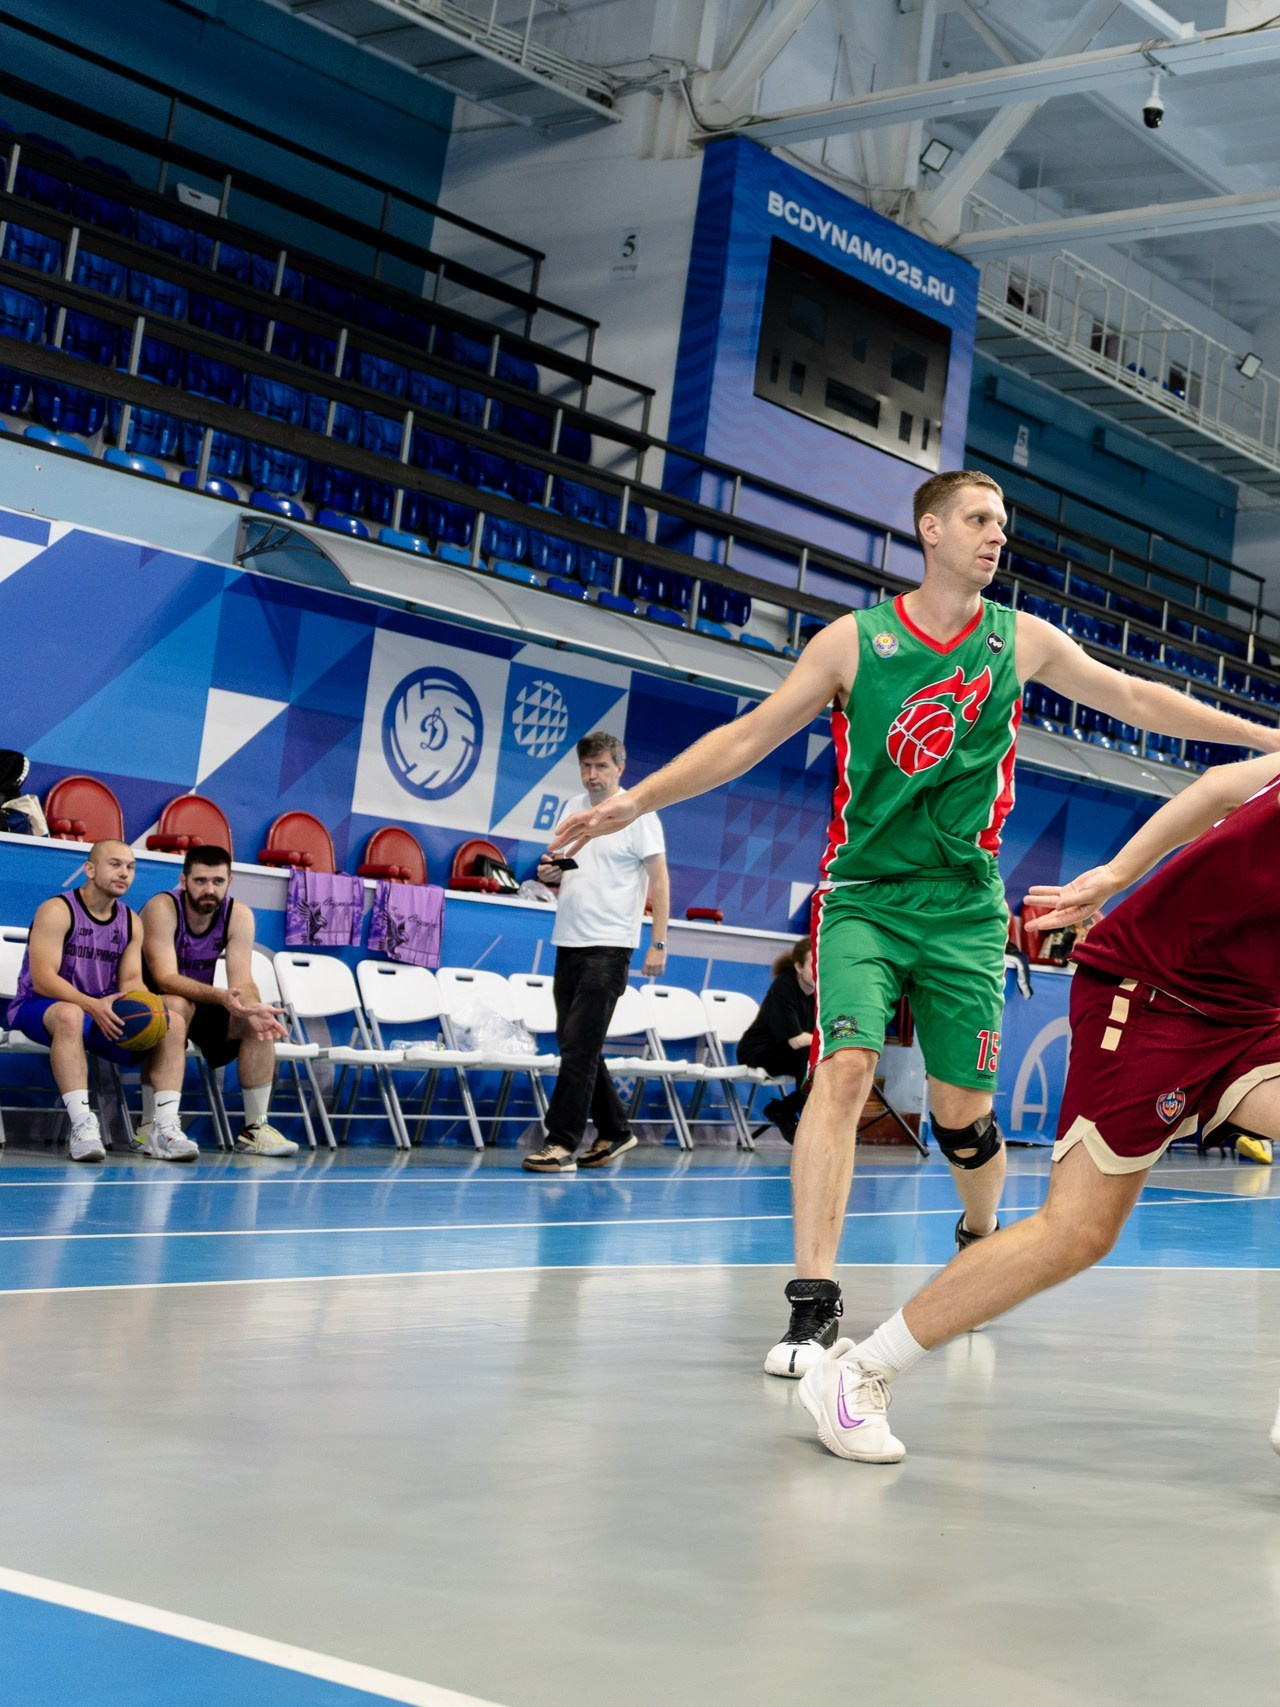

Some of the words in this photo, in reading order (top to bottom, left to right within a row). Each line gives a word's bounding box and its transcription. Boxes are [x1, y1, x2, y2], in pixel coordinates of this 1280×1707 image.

[622, 234, 636, 258] 5
[767, 190, 955, 306] BCDYNAMO25.RU
[976, 1029, 1000, 1073] 15
